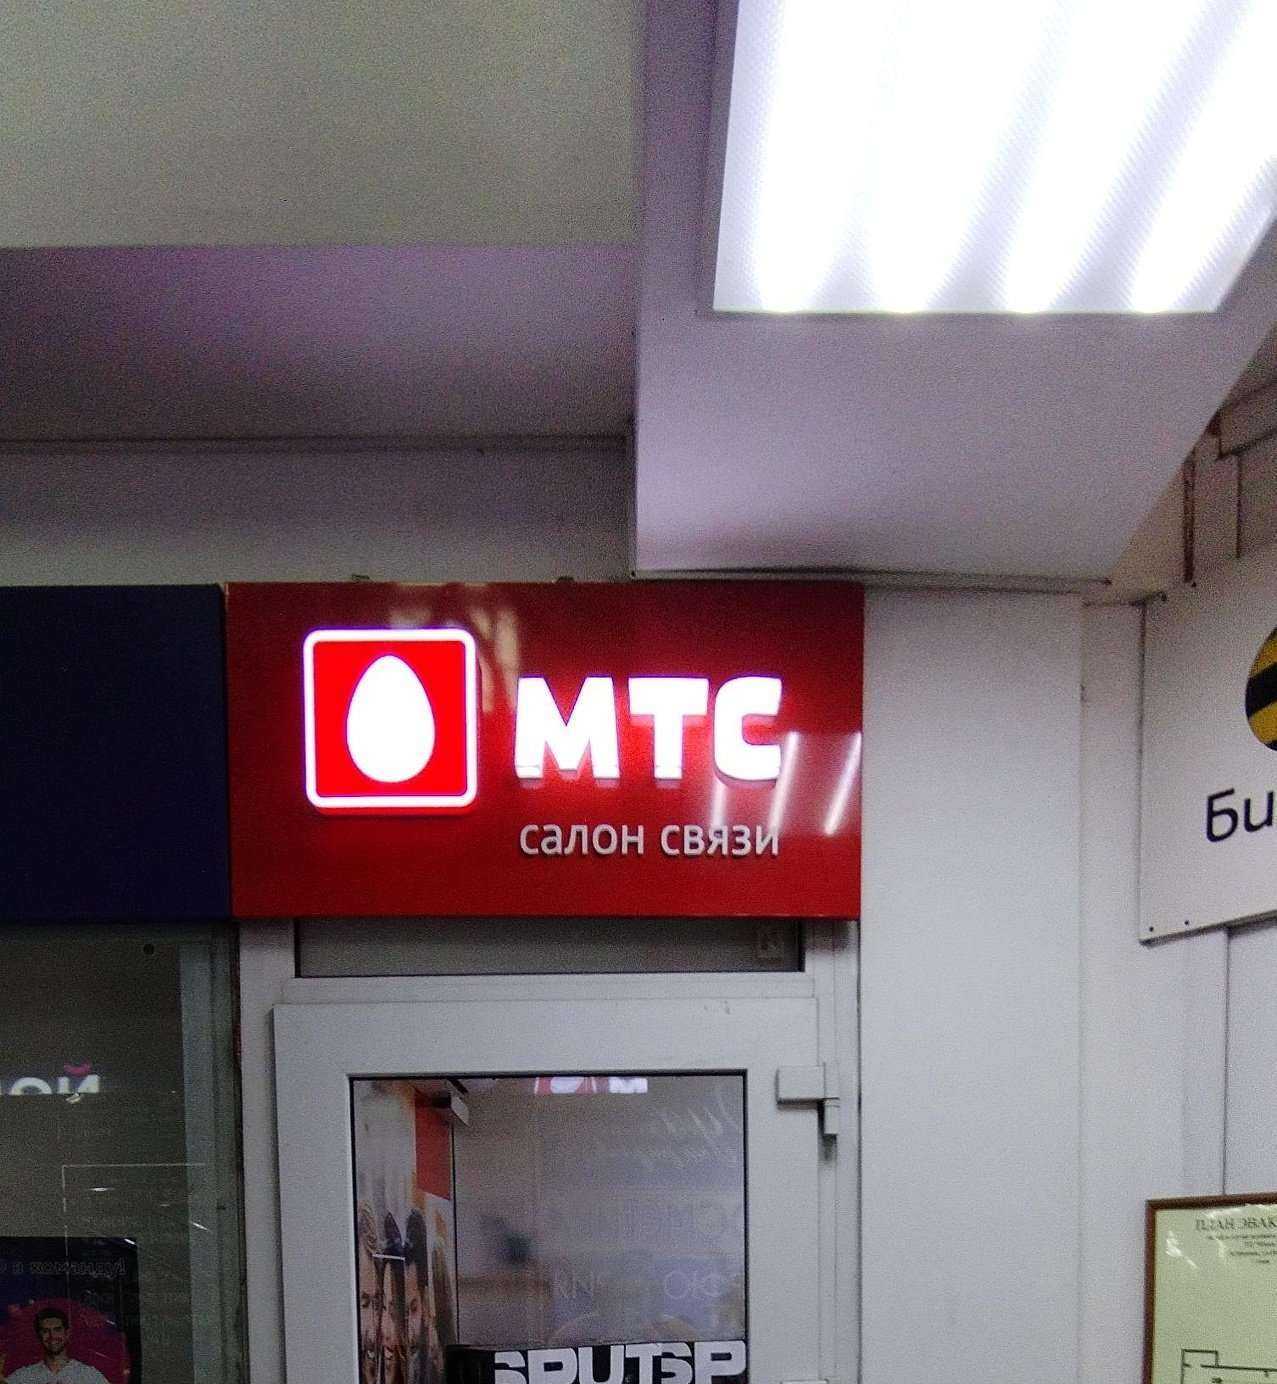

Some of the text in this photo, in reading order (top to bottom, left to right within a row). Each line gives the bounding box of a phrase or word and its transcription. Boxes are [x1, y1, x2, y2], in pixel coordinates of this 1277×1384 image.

[514, 675, 783, 781] МТС
[519, 823, 779, 856] салон связи
[1206, 788, 1275, 843] Би
